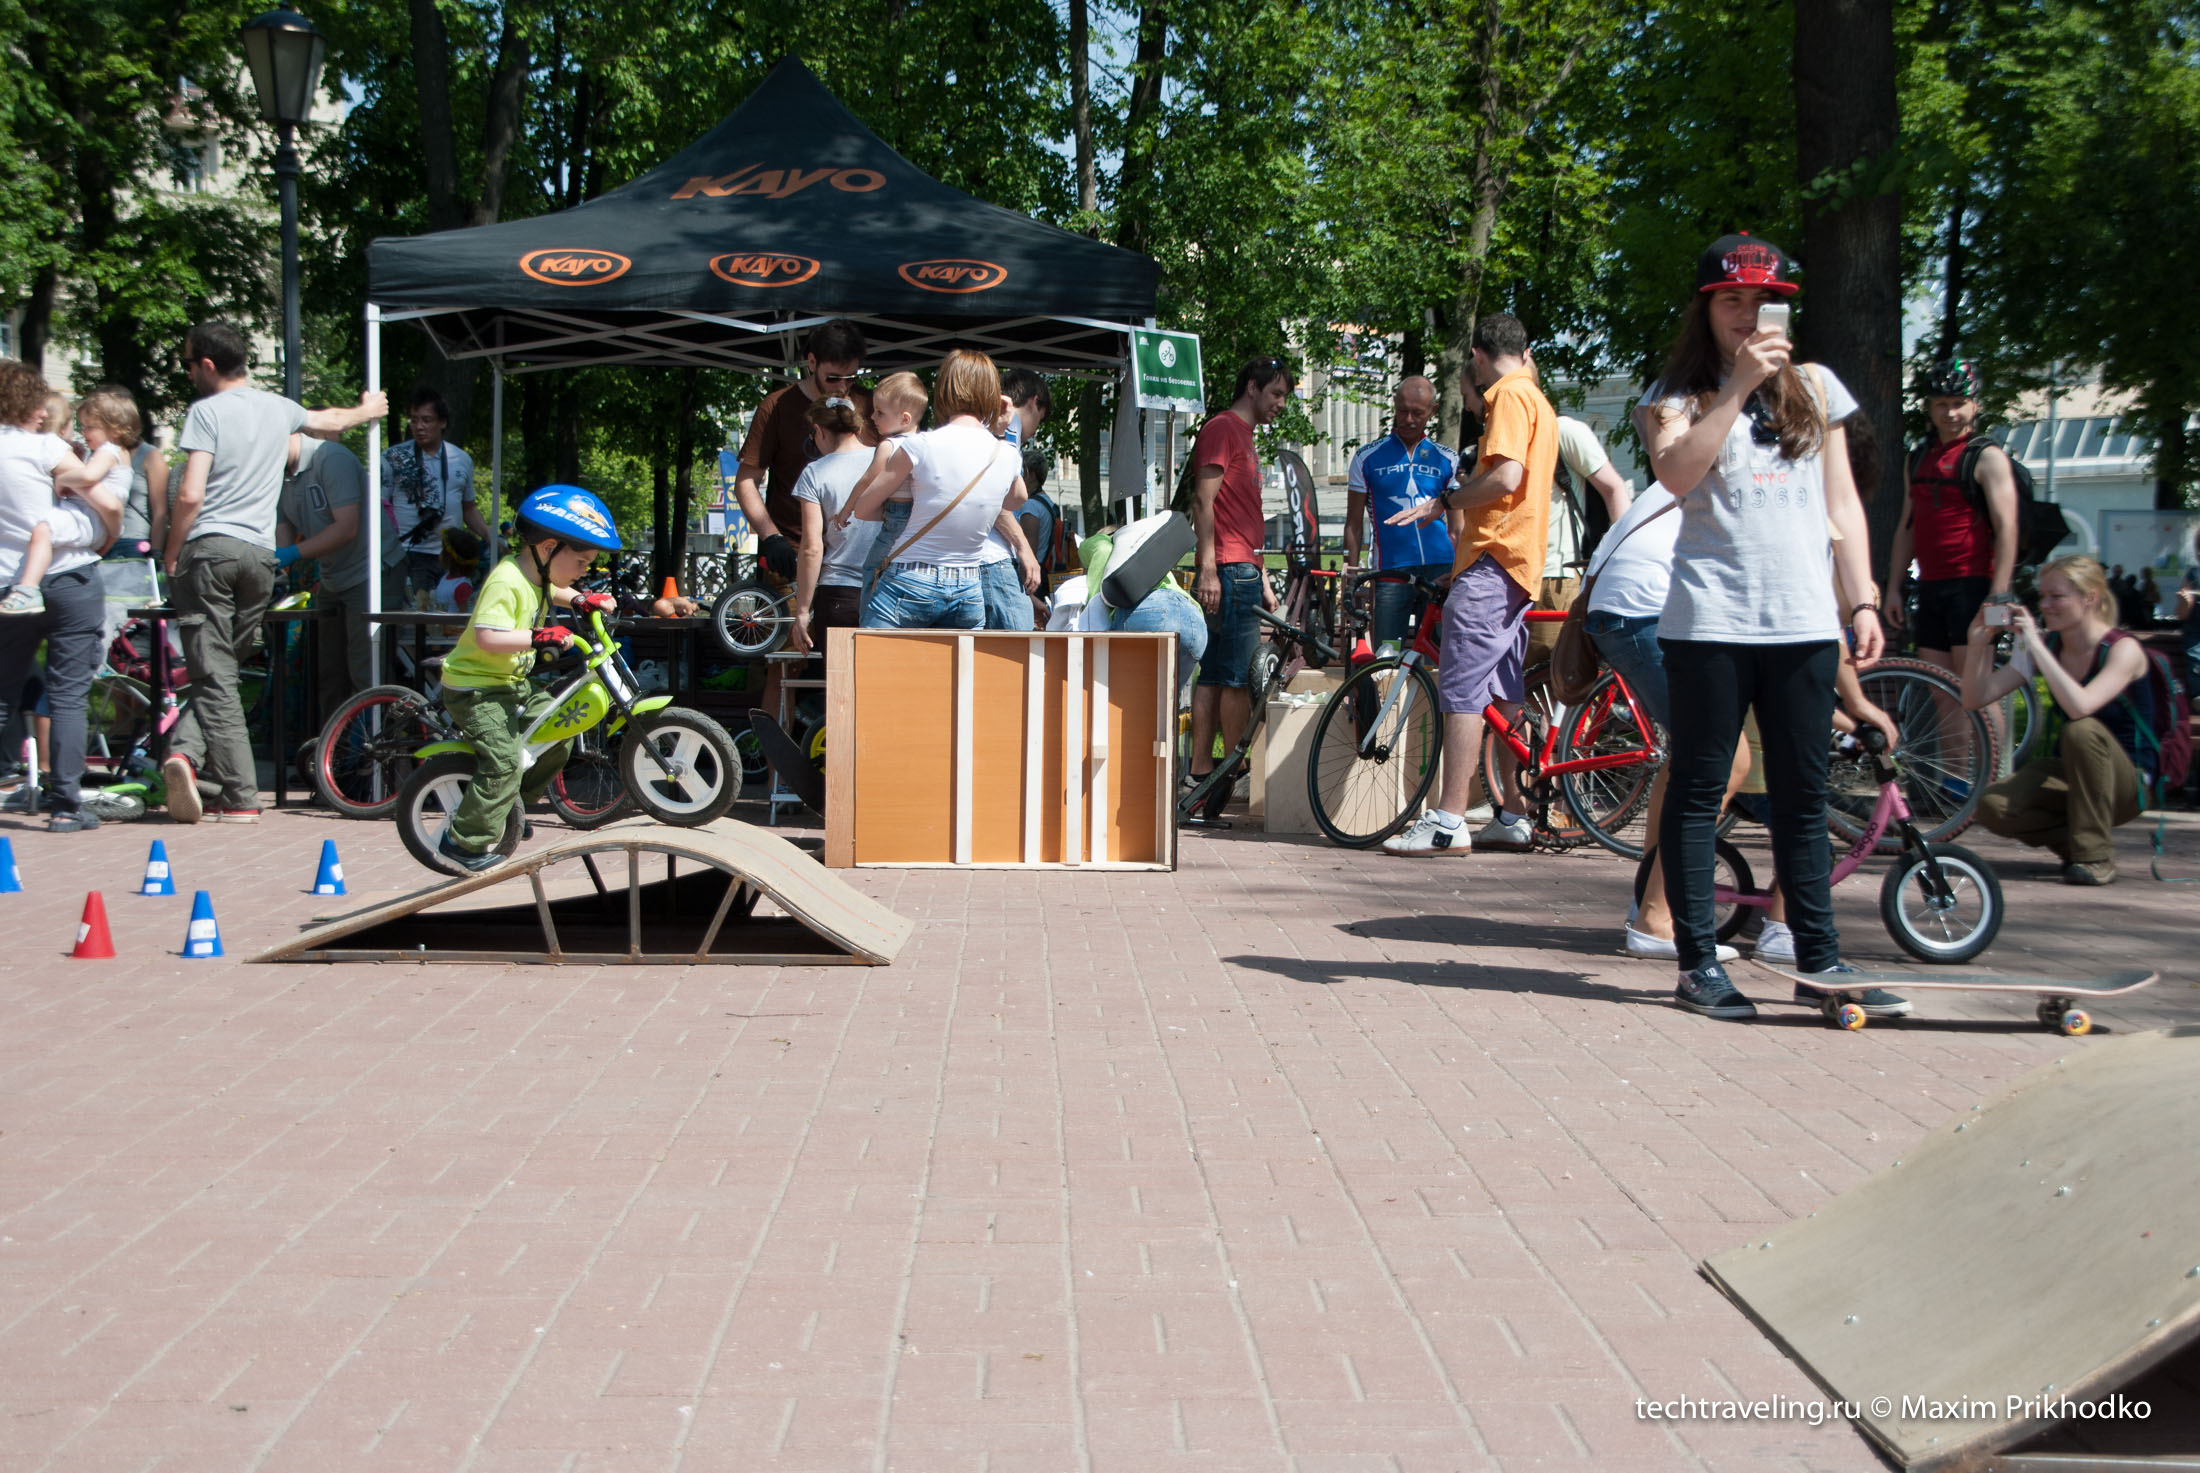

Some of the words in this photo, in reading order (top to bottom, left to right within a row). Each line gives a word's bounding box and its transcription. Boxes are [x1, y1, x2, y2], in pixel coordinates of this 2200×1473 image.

[670, 161, 887, 199] KAYO
[539, 254, 613, 276] KAYO
[728, 255, 802, 276] KAYO
[917, 264, 989, 284] KAYO
[1374, 463, 1442, 476] TRITON
[1753, 473, 1789, 484] NYC
[1729, 488, 1808, 509] 1969
